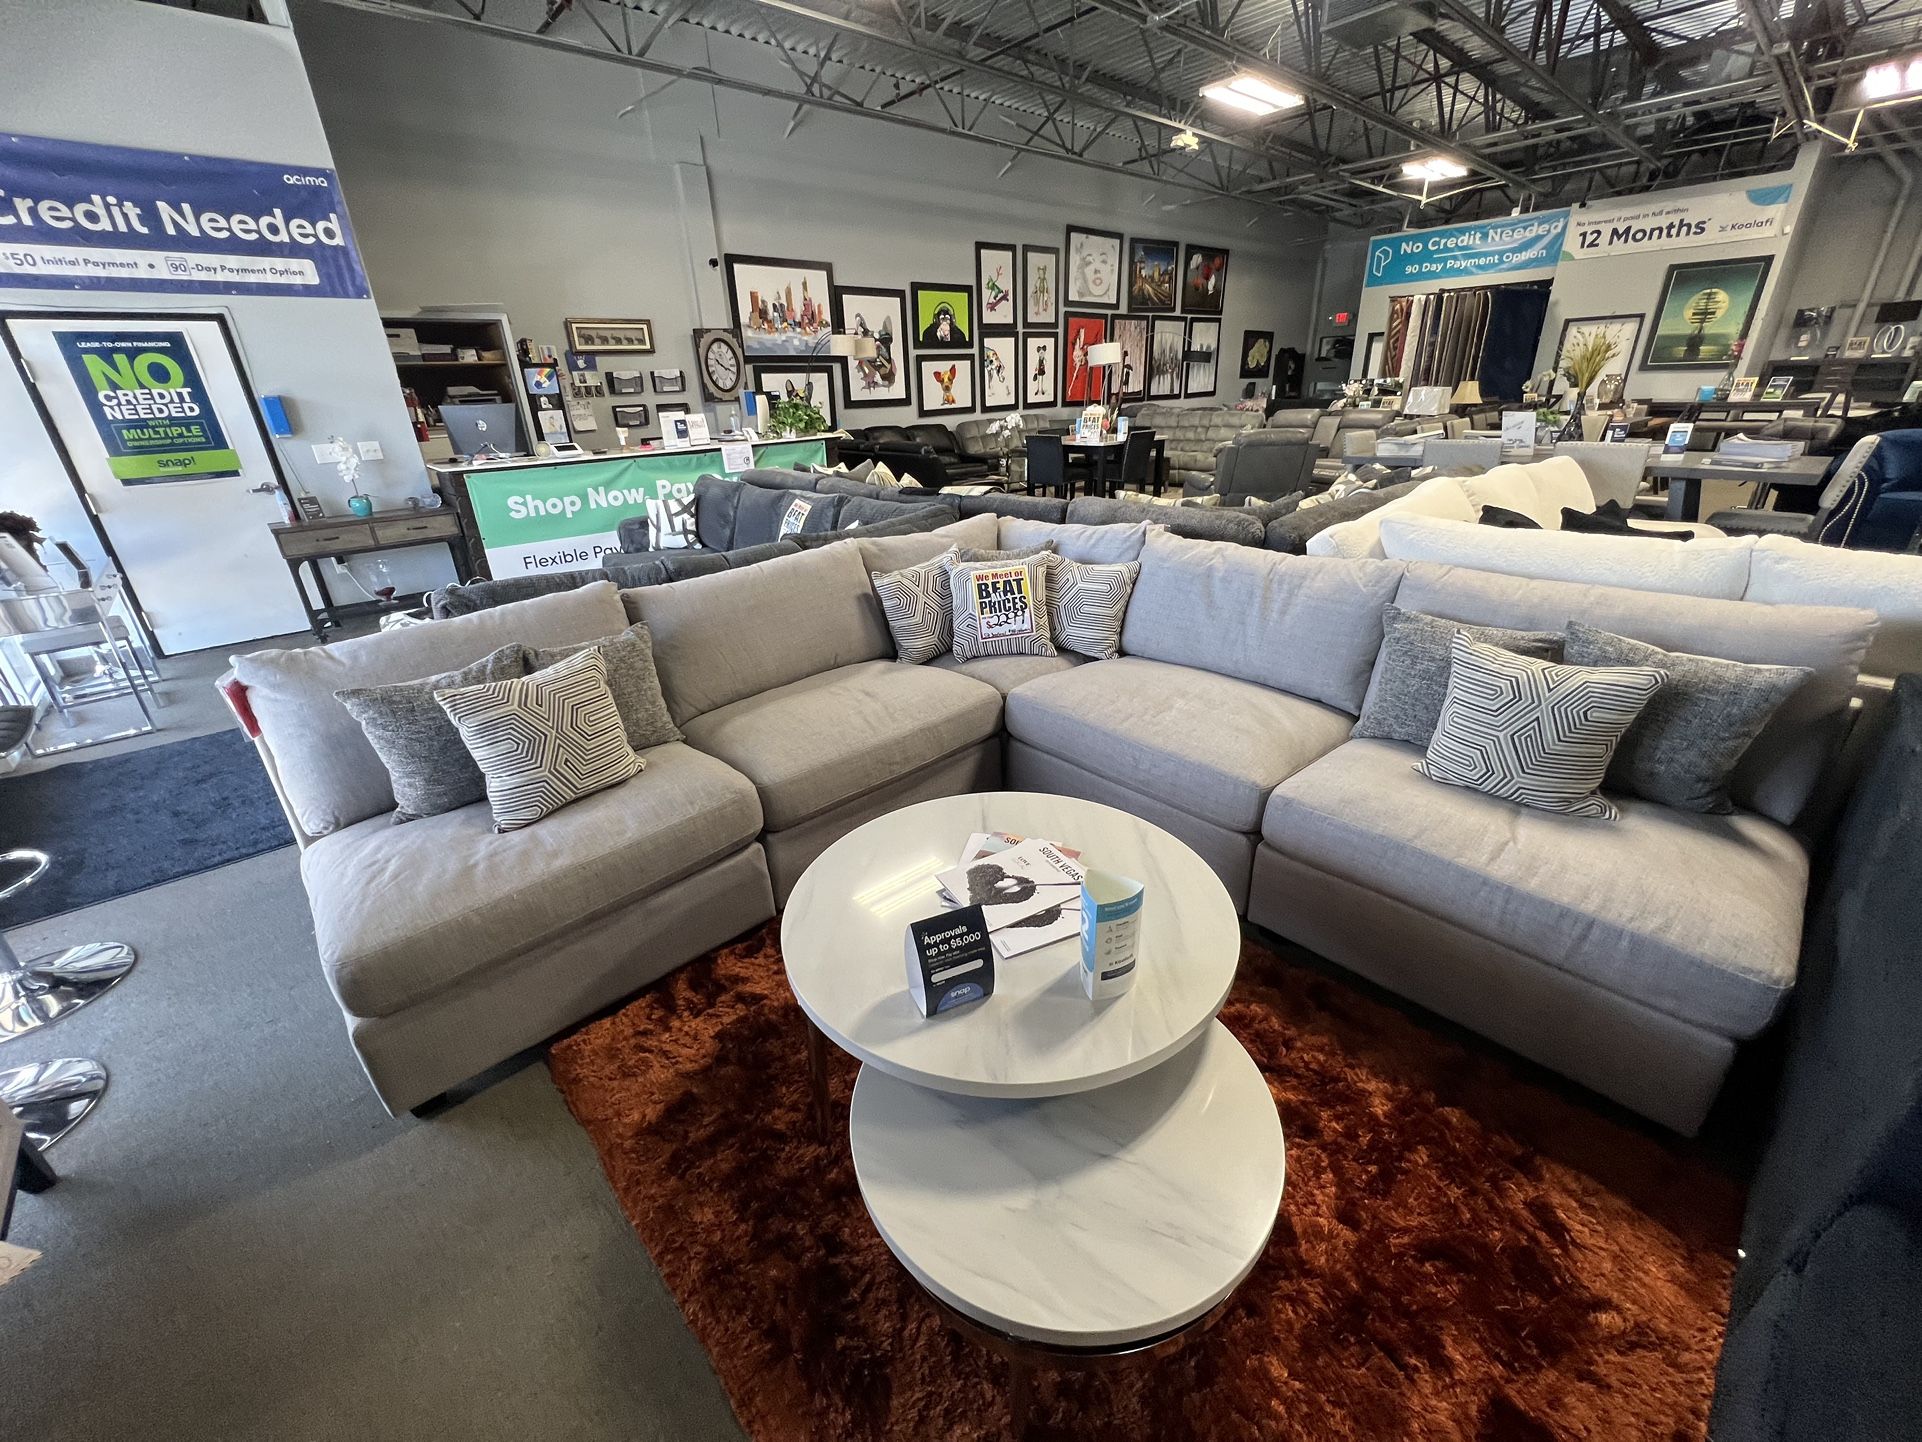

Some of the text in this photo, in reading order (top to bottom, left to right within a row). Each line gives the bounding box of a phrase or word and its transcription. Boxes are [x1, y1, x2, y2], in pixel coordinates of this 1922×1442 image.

[282, 173, 328, 187] acima
[156, 201, 345, 246] Needed
[1729, 217, 1774, 231] Koalafi
[1400, 218, 1564, 255] No Credit Needed
[1578, 229, 1602, 250] 12
[41, 256, 81, 267] Initial
[84, 258, 139, 270] Payment
[220, 265, 268, 276] Payment
[271, 267, 305, 278] Option
[1404, 249, 1547, 275] 90 Day Payment Option
[81, 352, 185, 391] NO
[97, 387, 193, 406] CREDIT
[102, 402, 200, 420] NEEDED
[121, 425, 203, 440] MULTIPLE
[157, 456, 197, 469] snap!
[507, 494, 582, 519] Shop
[523, 548, 589, 570] Flexible
[976, 570, 1024, 582] We Meet or
[977, 578, 1024, 600] BEAT
[979, 595, 1028, 616] PRICES
[1039, 846, 1063, 865] SOUTH
[1059, 862, 1083, 881] VEGAS
[924, 925, 968, 945] Approvals
[926, 946, 938, 956] up
[939, 942, 949, 951] to
